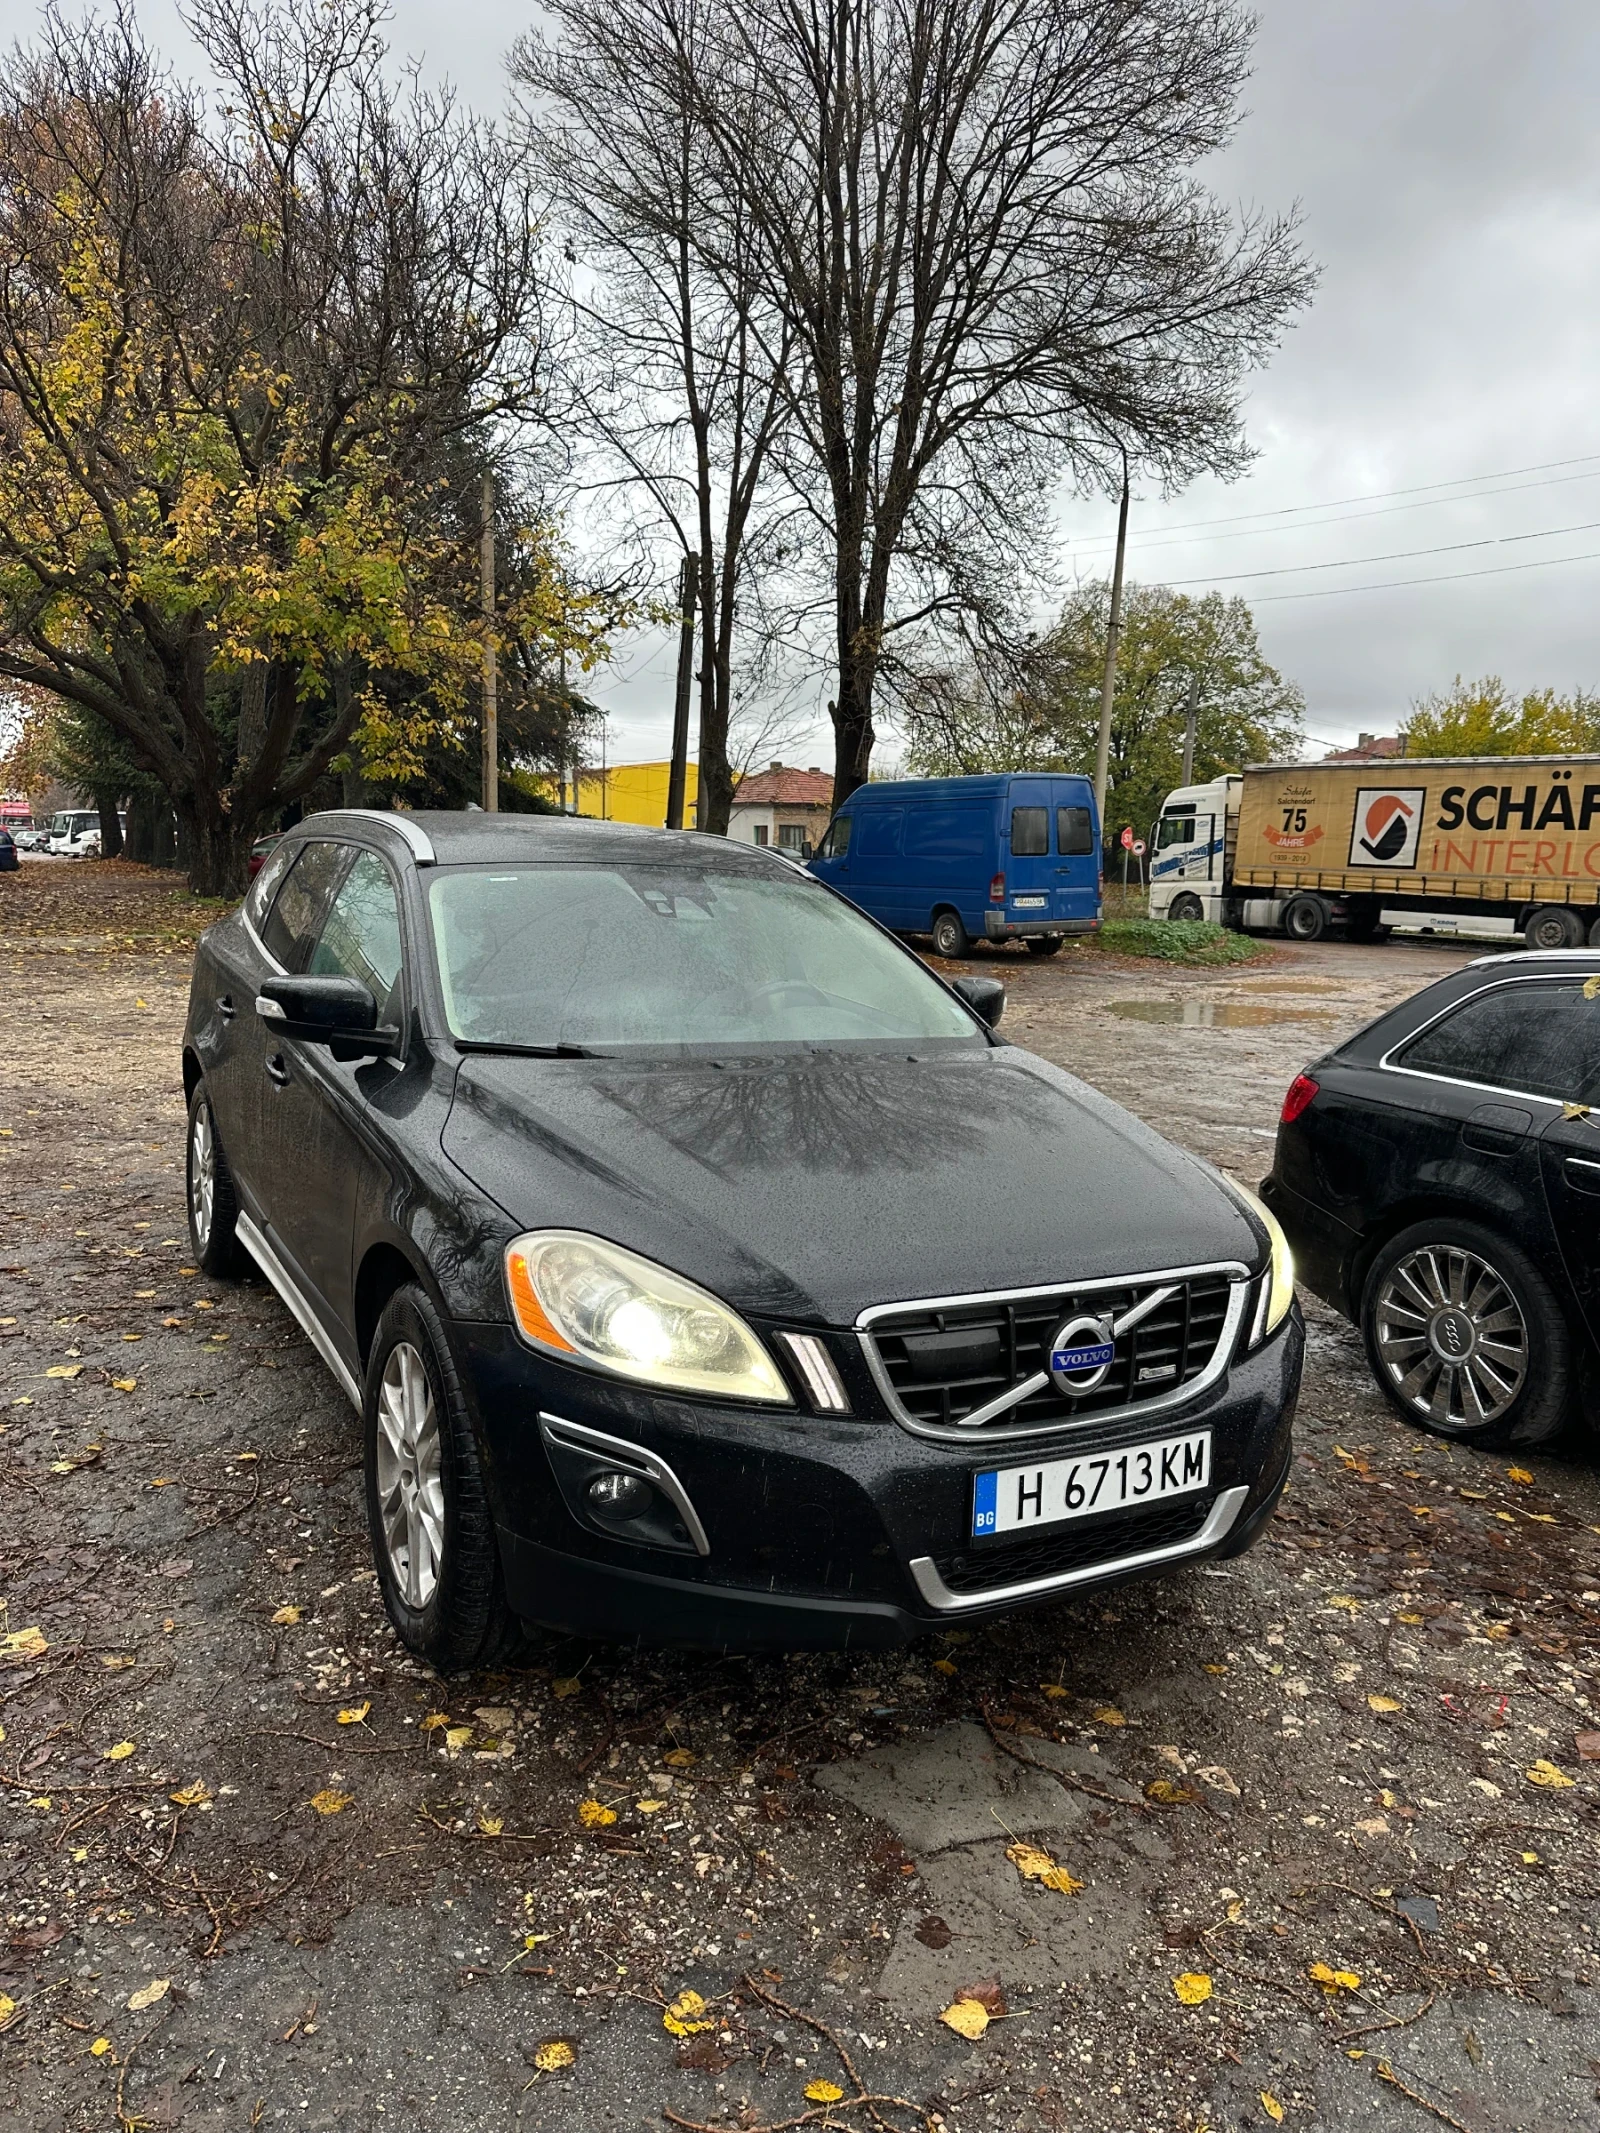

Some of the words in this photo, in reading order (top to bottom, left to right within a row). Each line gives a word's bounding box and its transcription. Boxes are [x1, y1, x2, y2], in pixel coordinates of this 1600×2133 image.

[1282, 808, 1308, 833] 75
[1276, 837, 1305, 847] JAHRE
[1291, 854, 1307, 862] 2014
[1057, 1349, 1111, 1366] VOLVO
[1017, 1471, 1043, 1521] H
[976, 1510, 995, 1528] BG
